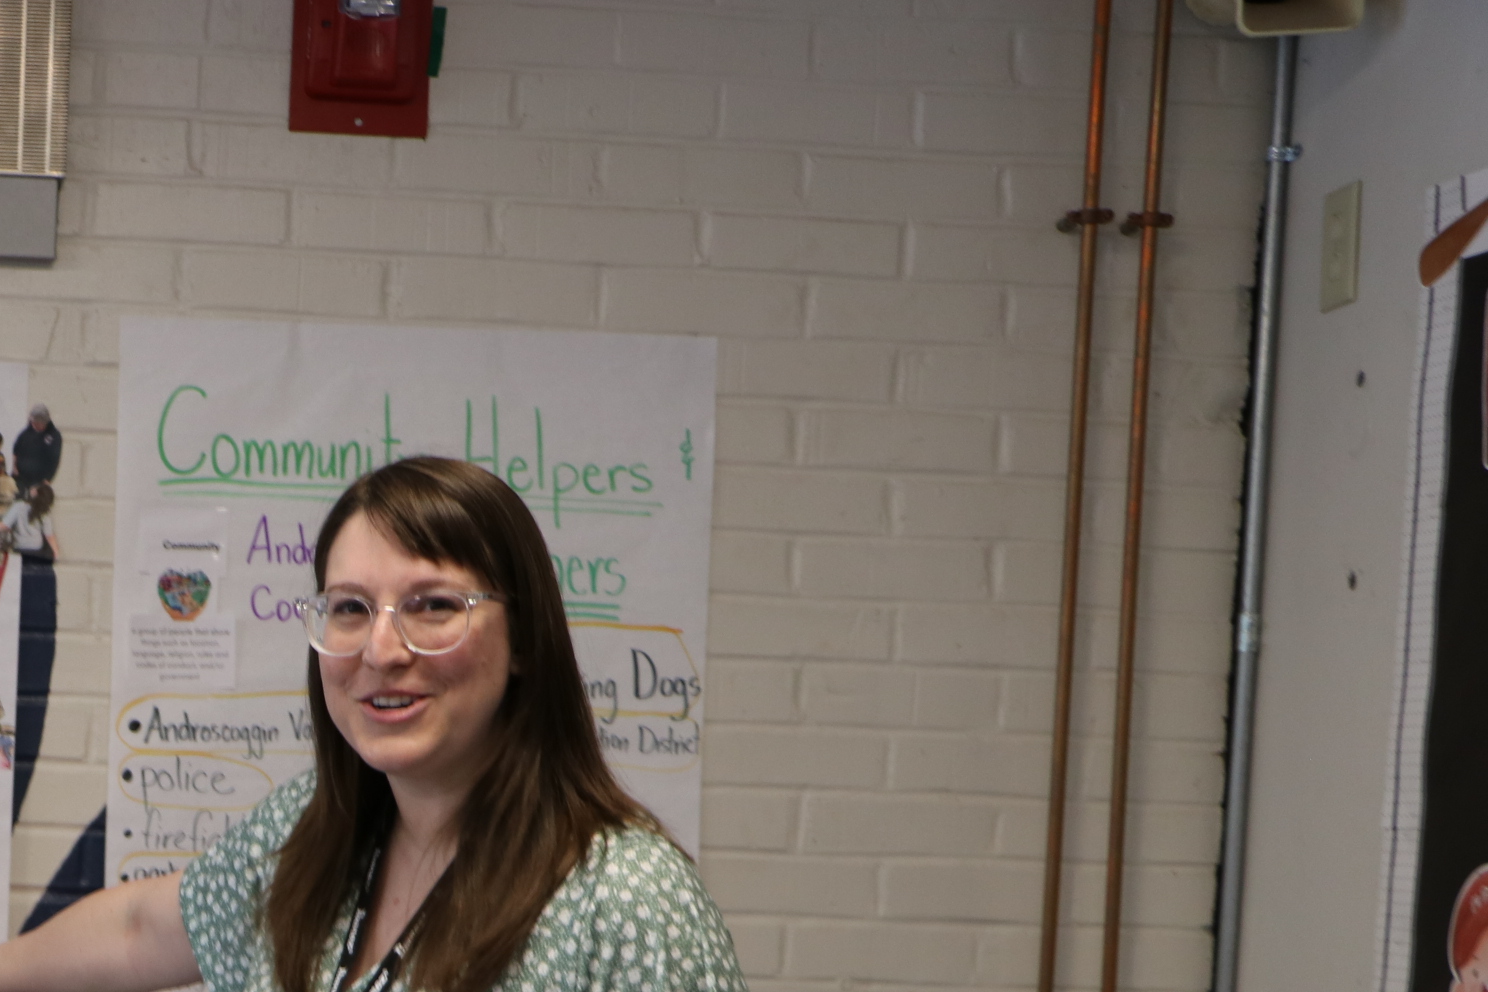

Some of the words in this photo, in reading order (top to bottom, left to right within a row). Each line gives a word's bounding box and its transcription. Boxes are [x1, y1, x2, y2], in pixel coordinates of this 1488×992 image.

[158, 384, 426, 483] Communit
[465, 394, 654, 529] Helpers
[162, 540, 220, 552] Community
[247, 514, 316, 565] Andr
[144, 705, 279, 760] Androscoggin
[288, 708, 314, 742] Va
[630, 646, 702, 722] Dogs
[599, 726, 630, 753] tion
[638, 721, 700, 756] District
[140, 754, 236, 815] police
